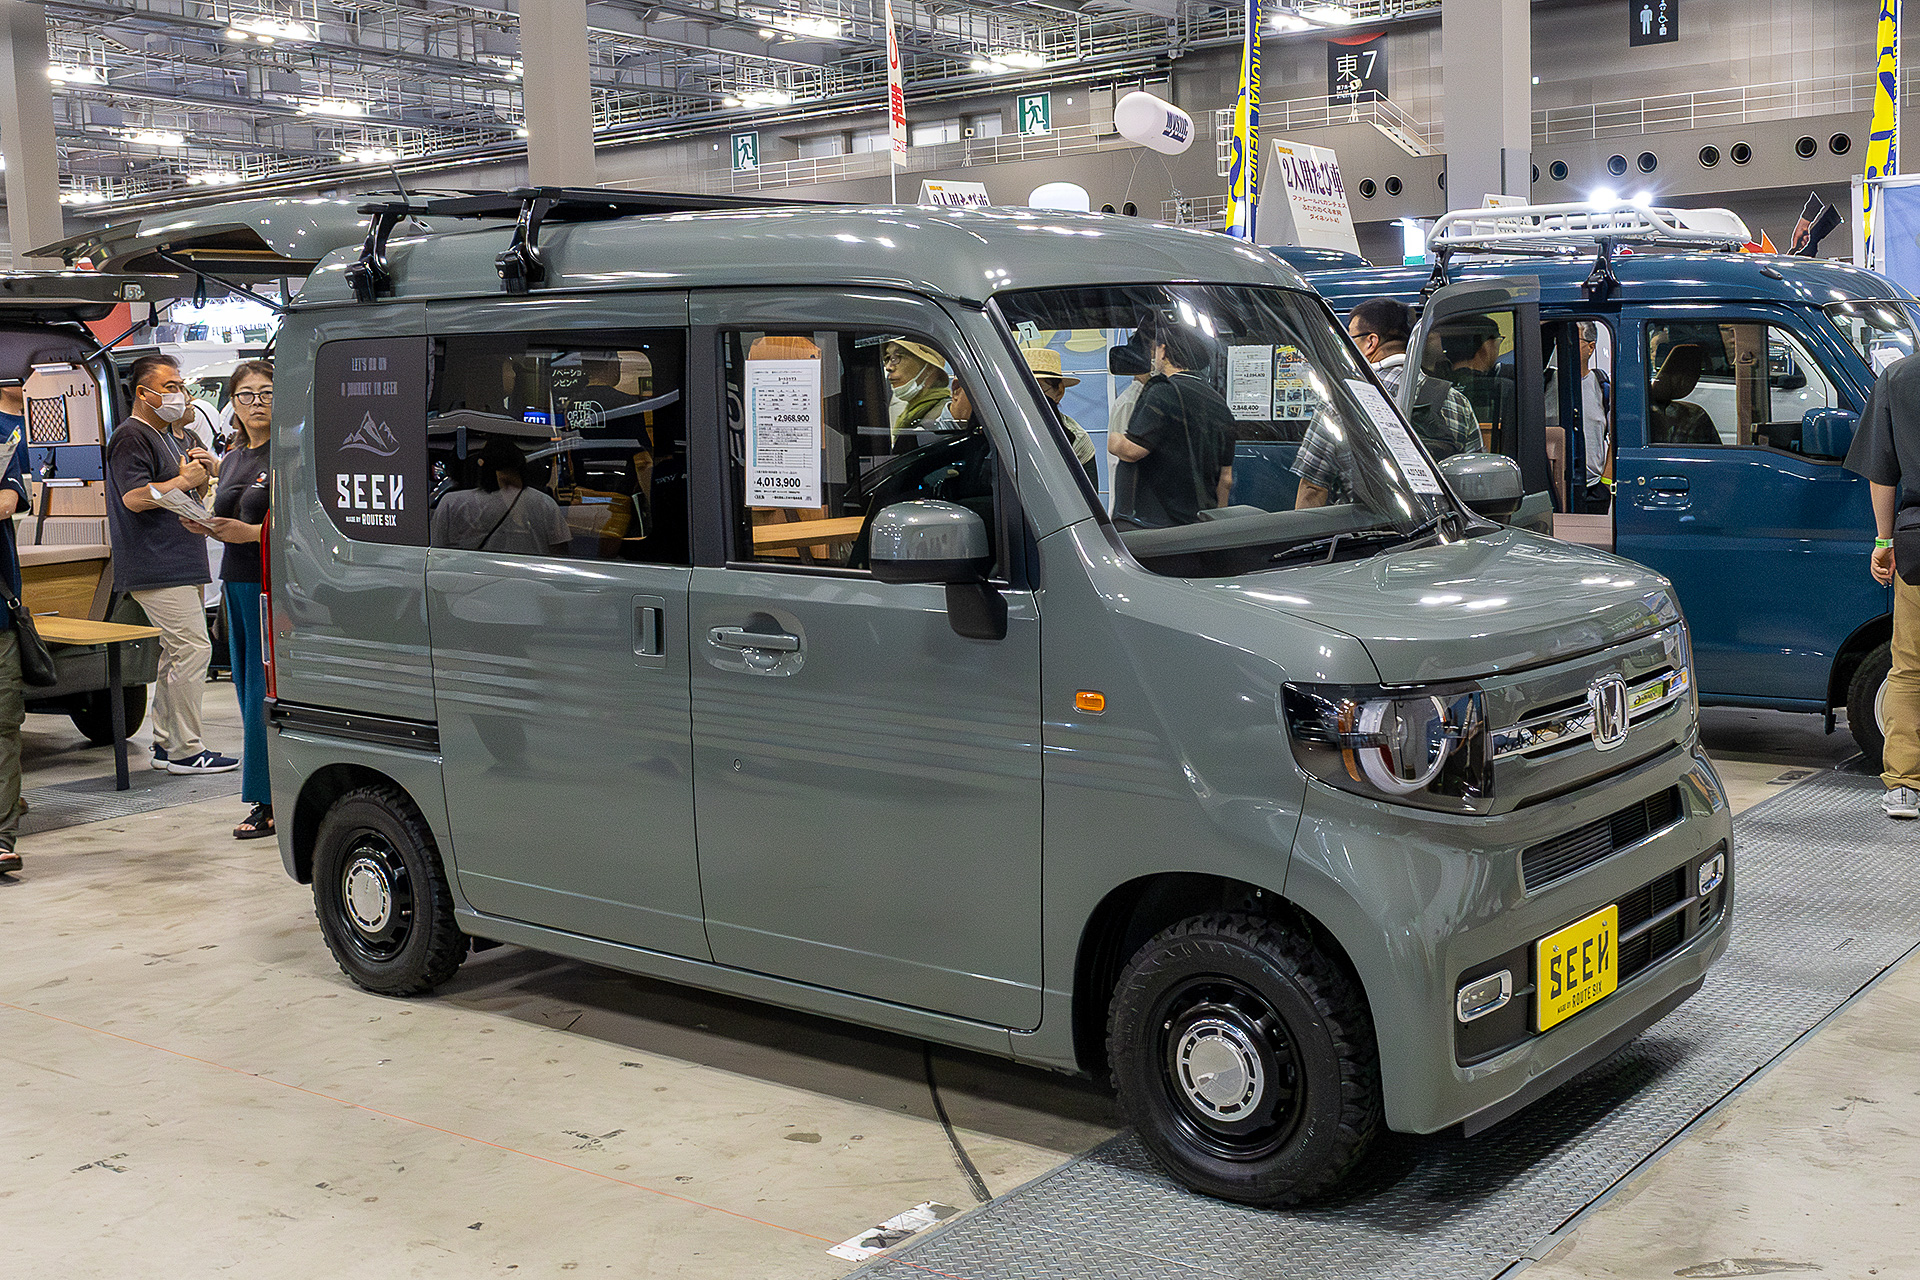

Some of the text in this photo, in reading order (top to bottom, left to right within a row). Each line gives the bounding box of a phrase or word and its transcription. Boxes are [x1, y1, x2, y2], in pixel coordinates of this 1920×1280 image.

[1249, 125, 1259, 206] VEHICLE
[574, 401, 591, 410] THE
[567, 411, 592, 420] ORTH
[361, 513, 384, 526] ROUTE
[384, 514, 397, 526] SIX
[1571, 985, 1591, 1008] ROUTE
[1592, 980, 1603, 1000] SIX
